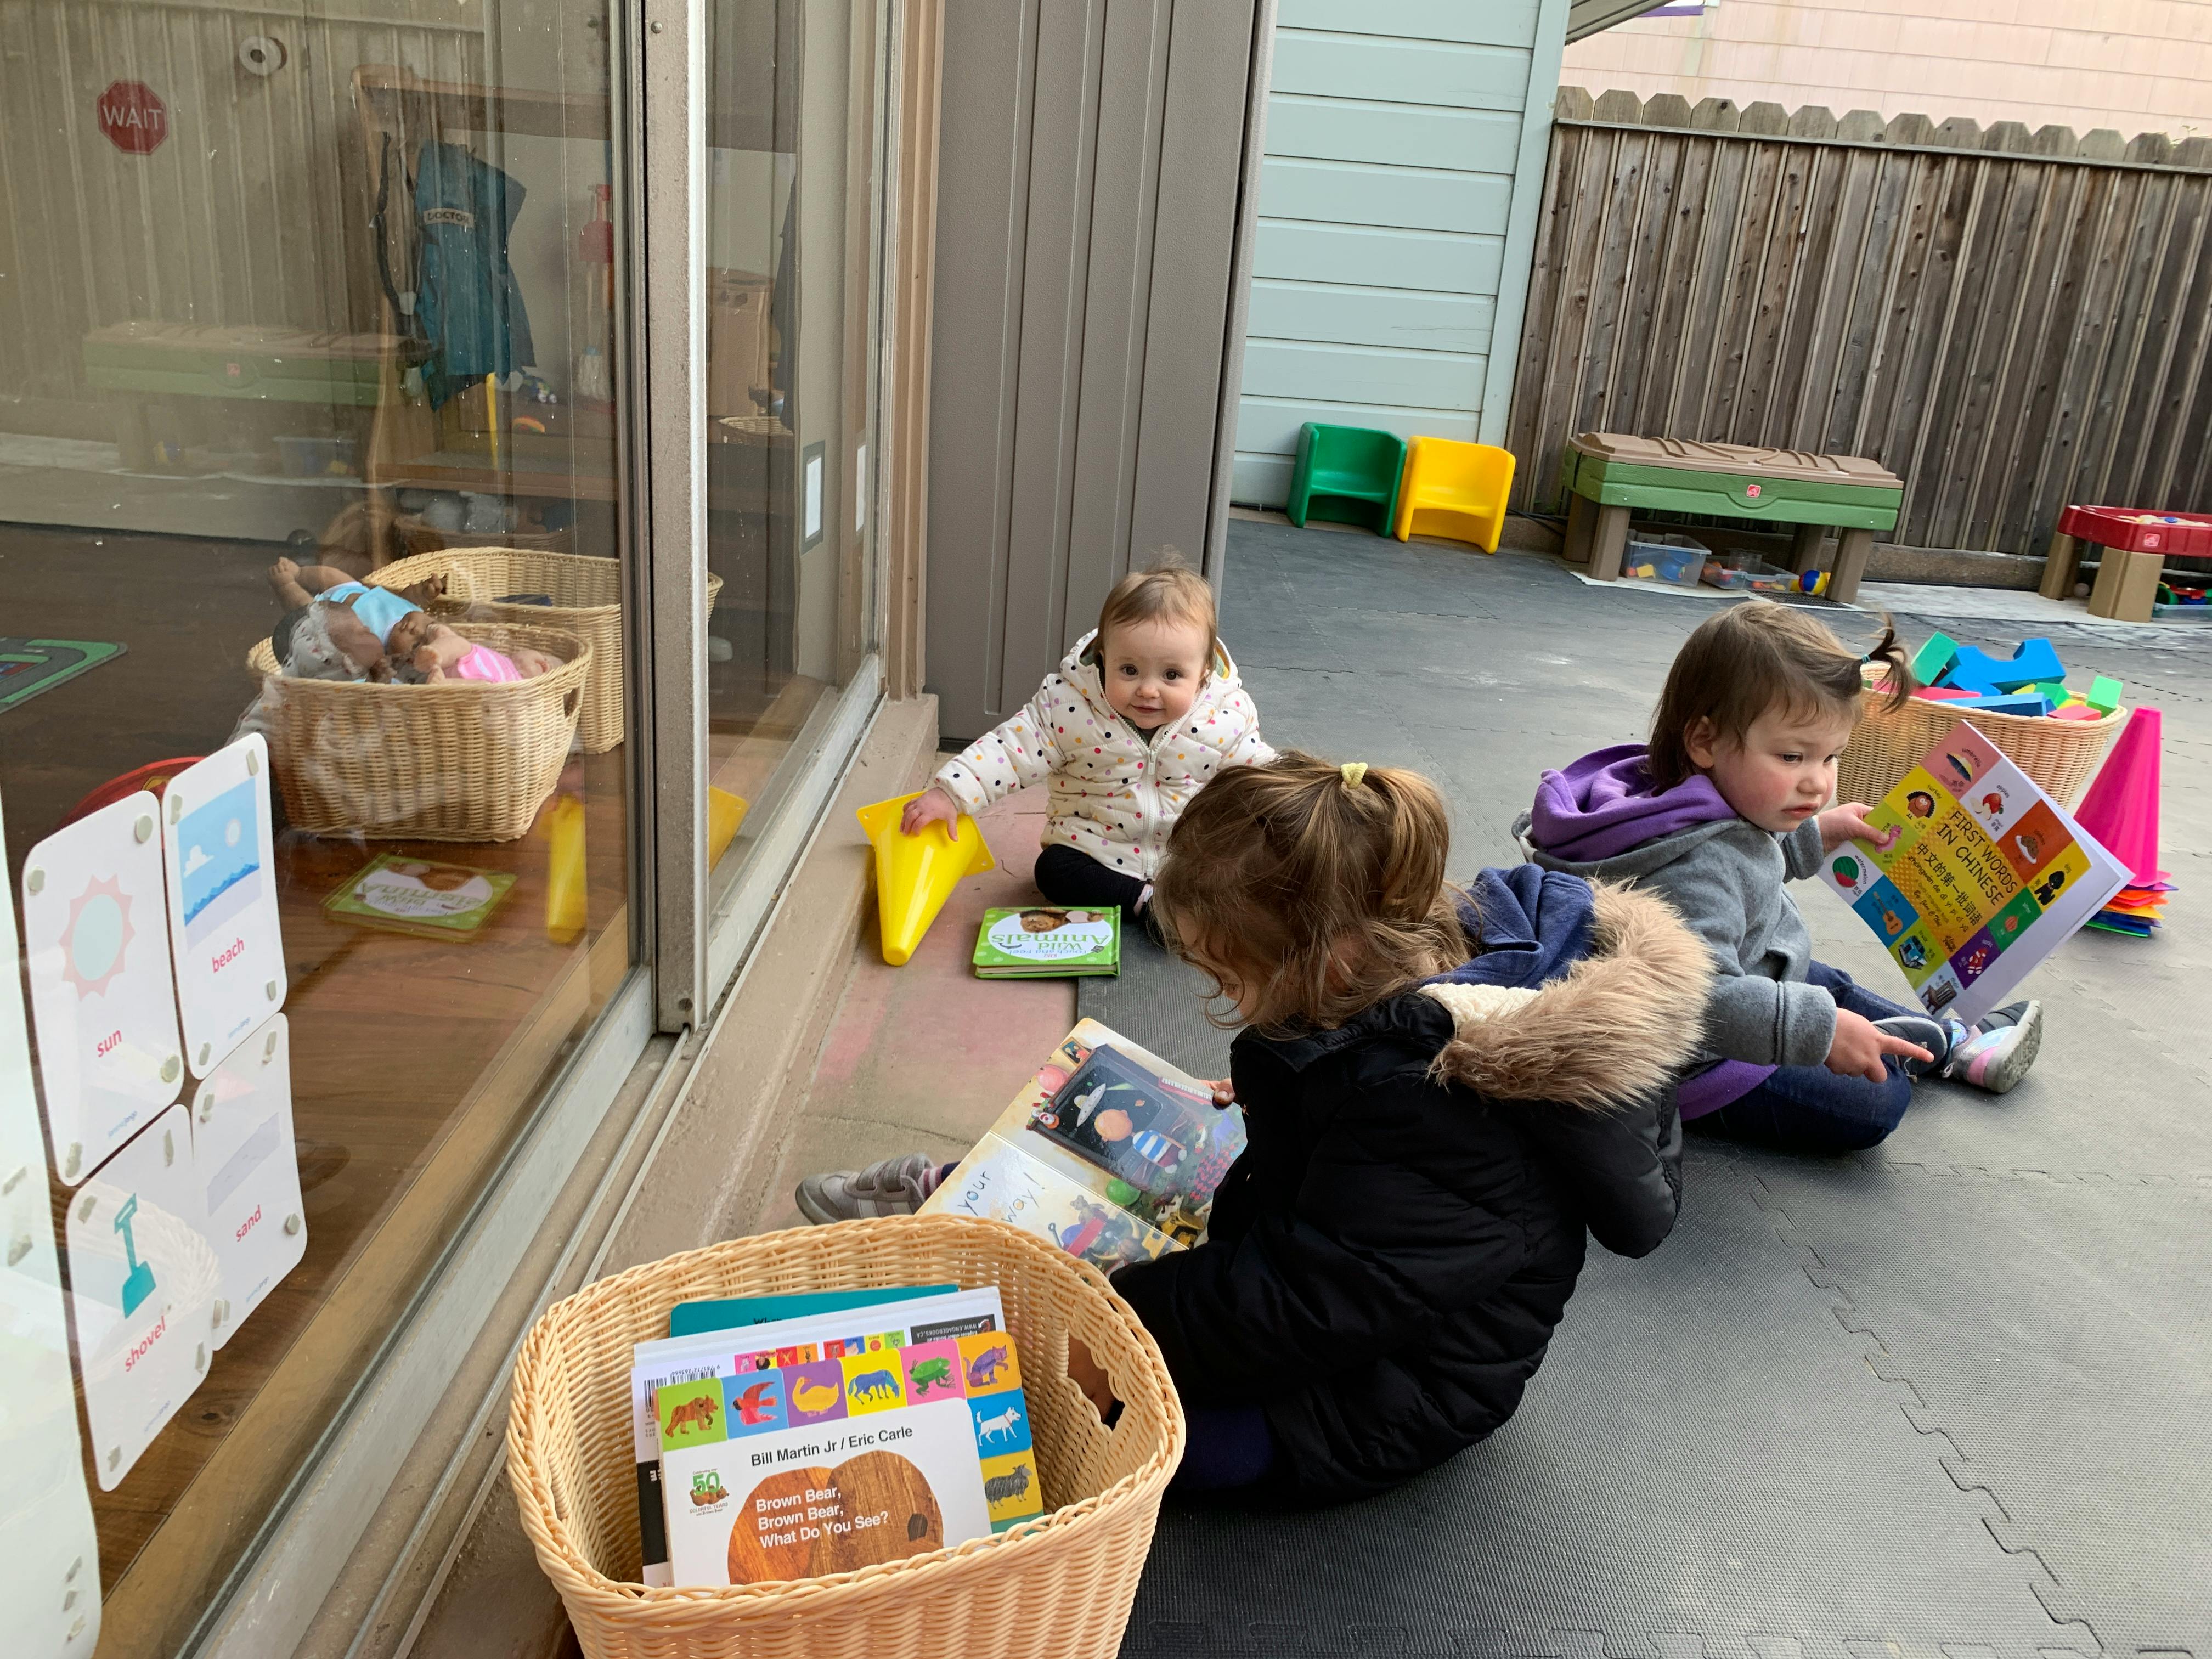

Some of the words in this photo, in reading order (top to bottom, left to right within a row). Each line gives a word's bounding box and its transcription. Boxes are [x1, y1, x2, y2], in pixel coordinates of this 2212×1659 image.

[103, 105, 162, 130] WAIT
[1855, 855, 1867, 884] watermelon
[1937, 824, 1958, 845] IN
[1956, 847, 2004, 906] CHINESE
[1949, 810, 1985, 847] FIRST
[1982, 845, 2017, 893] WORDS
[1917, 843, 1984, 926] 中文的第一批词语
[212, 937, 245, 973] beach
[991, 934, 1110, 945] Animals
[97, 1030, 122, 1058] sun
[957, 1171, 991, 1217] your
[1001, 1172, 1045, 1223] way!
[236, 1204, 261, 1243] sand
[125, 1315, 165, 1372] shovel
[751, 1452, 772, 1466] Bill
[777, 1444, 820, 1462] Martin
[824, 1440, 837, 1453] Jr
[840, 1437, 845, 1450] /
[849, 1434, 874, 1448] Eric
[878, 1426, 913, 1442] Carle
[693, 1471, 720, 1496] 50
[755, 1494, 802, 1513] Brown
[805, 1487, 841, 1502] Bear,
[758, 1513, 804, 1530] Brown
[807, 1504, 844, 1521] Bear,
[759, 1531, 797, 1549] What
[800, 1527, 820, 1541] Do
[823, 1521, 851, 1536] You
[855, 1510, 889, 1529] See?
